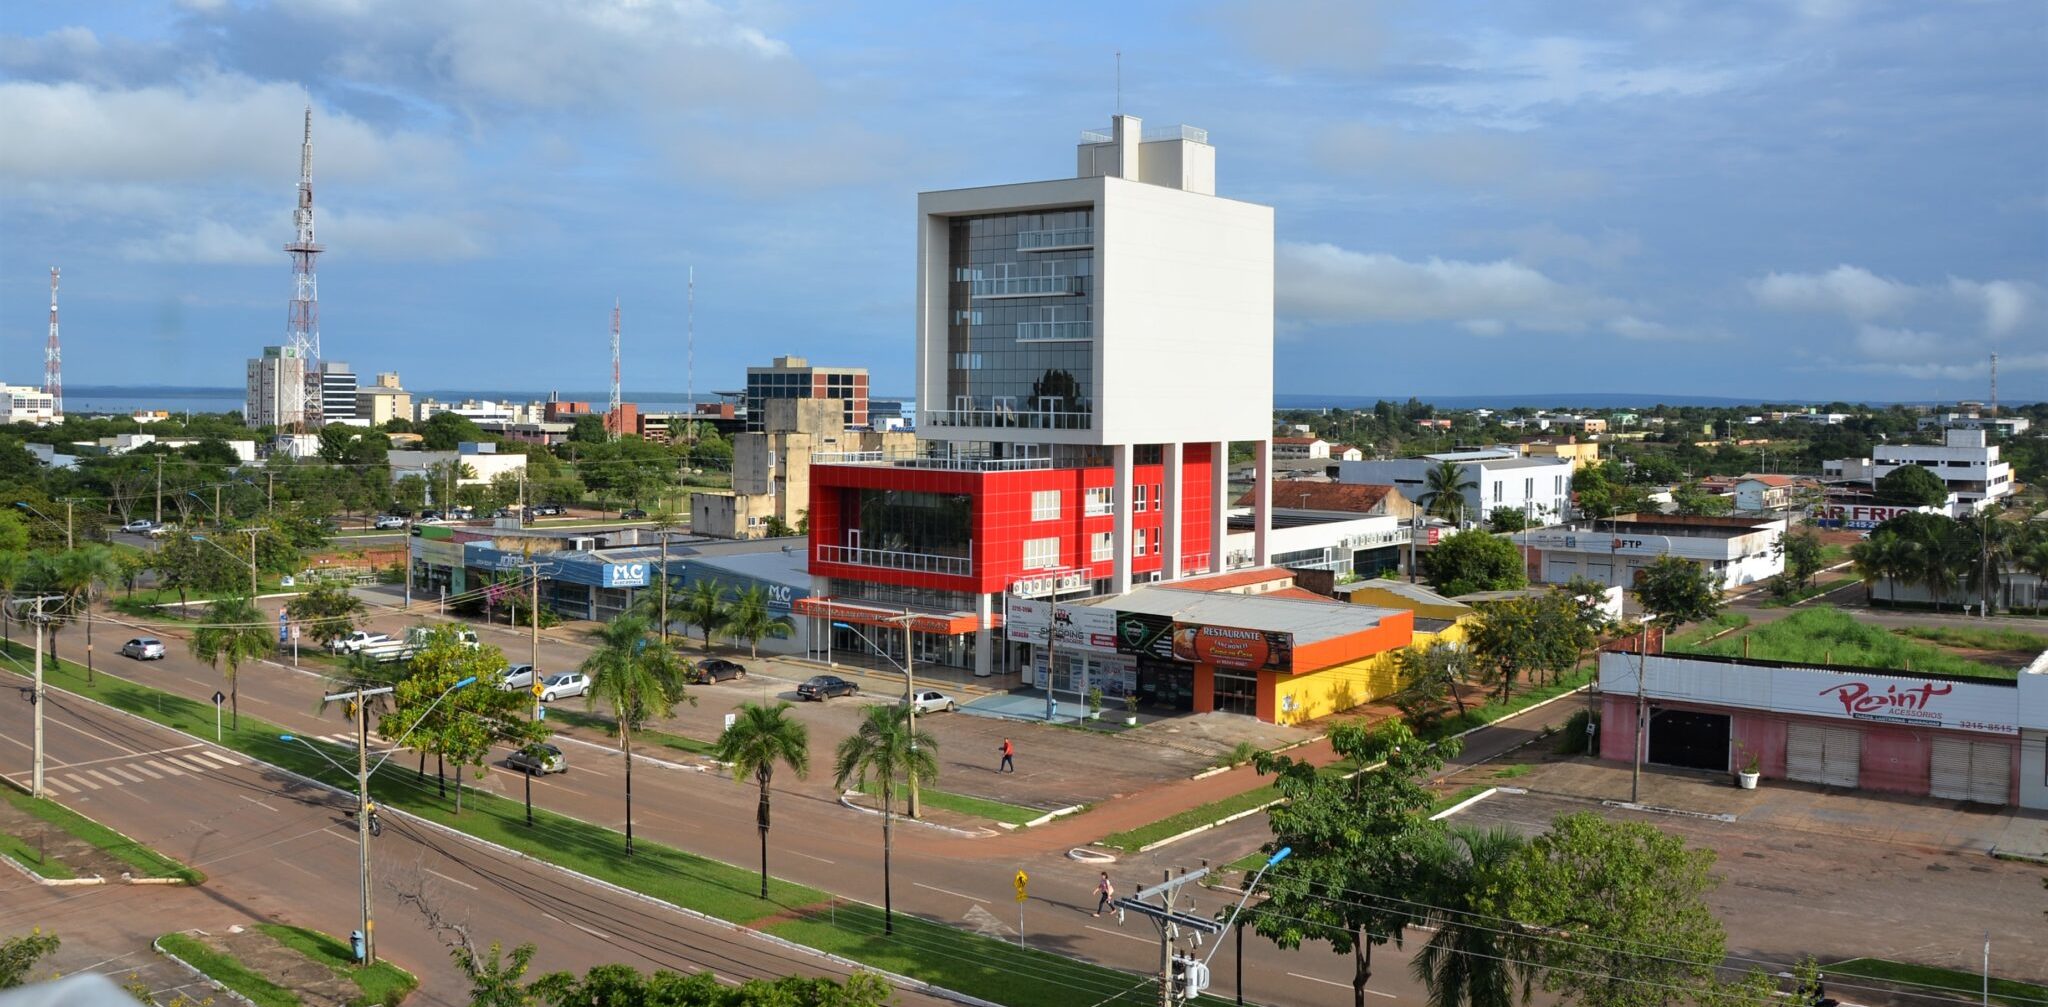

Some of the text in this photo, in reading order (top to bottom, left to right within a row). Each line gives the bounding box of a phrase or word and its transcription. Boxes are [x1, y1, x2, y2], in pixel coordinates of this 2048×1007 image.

[1622, 540, 1642, 549] FTP
[1203, 626, 1260, 641] RESTAURANTE
[1819, 682, 1952, 716] Point
